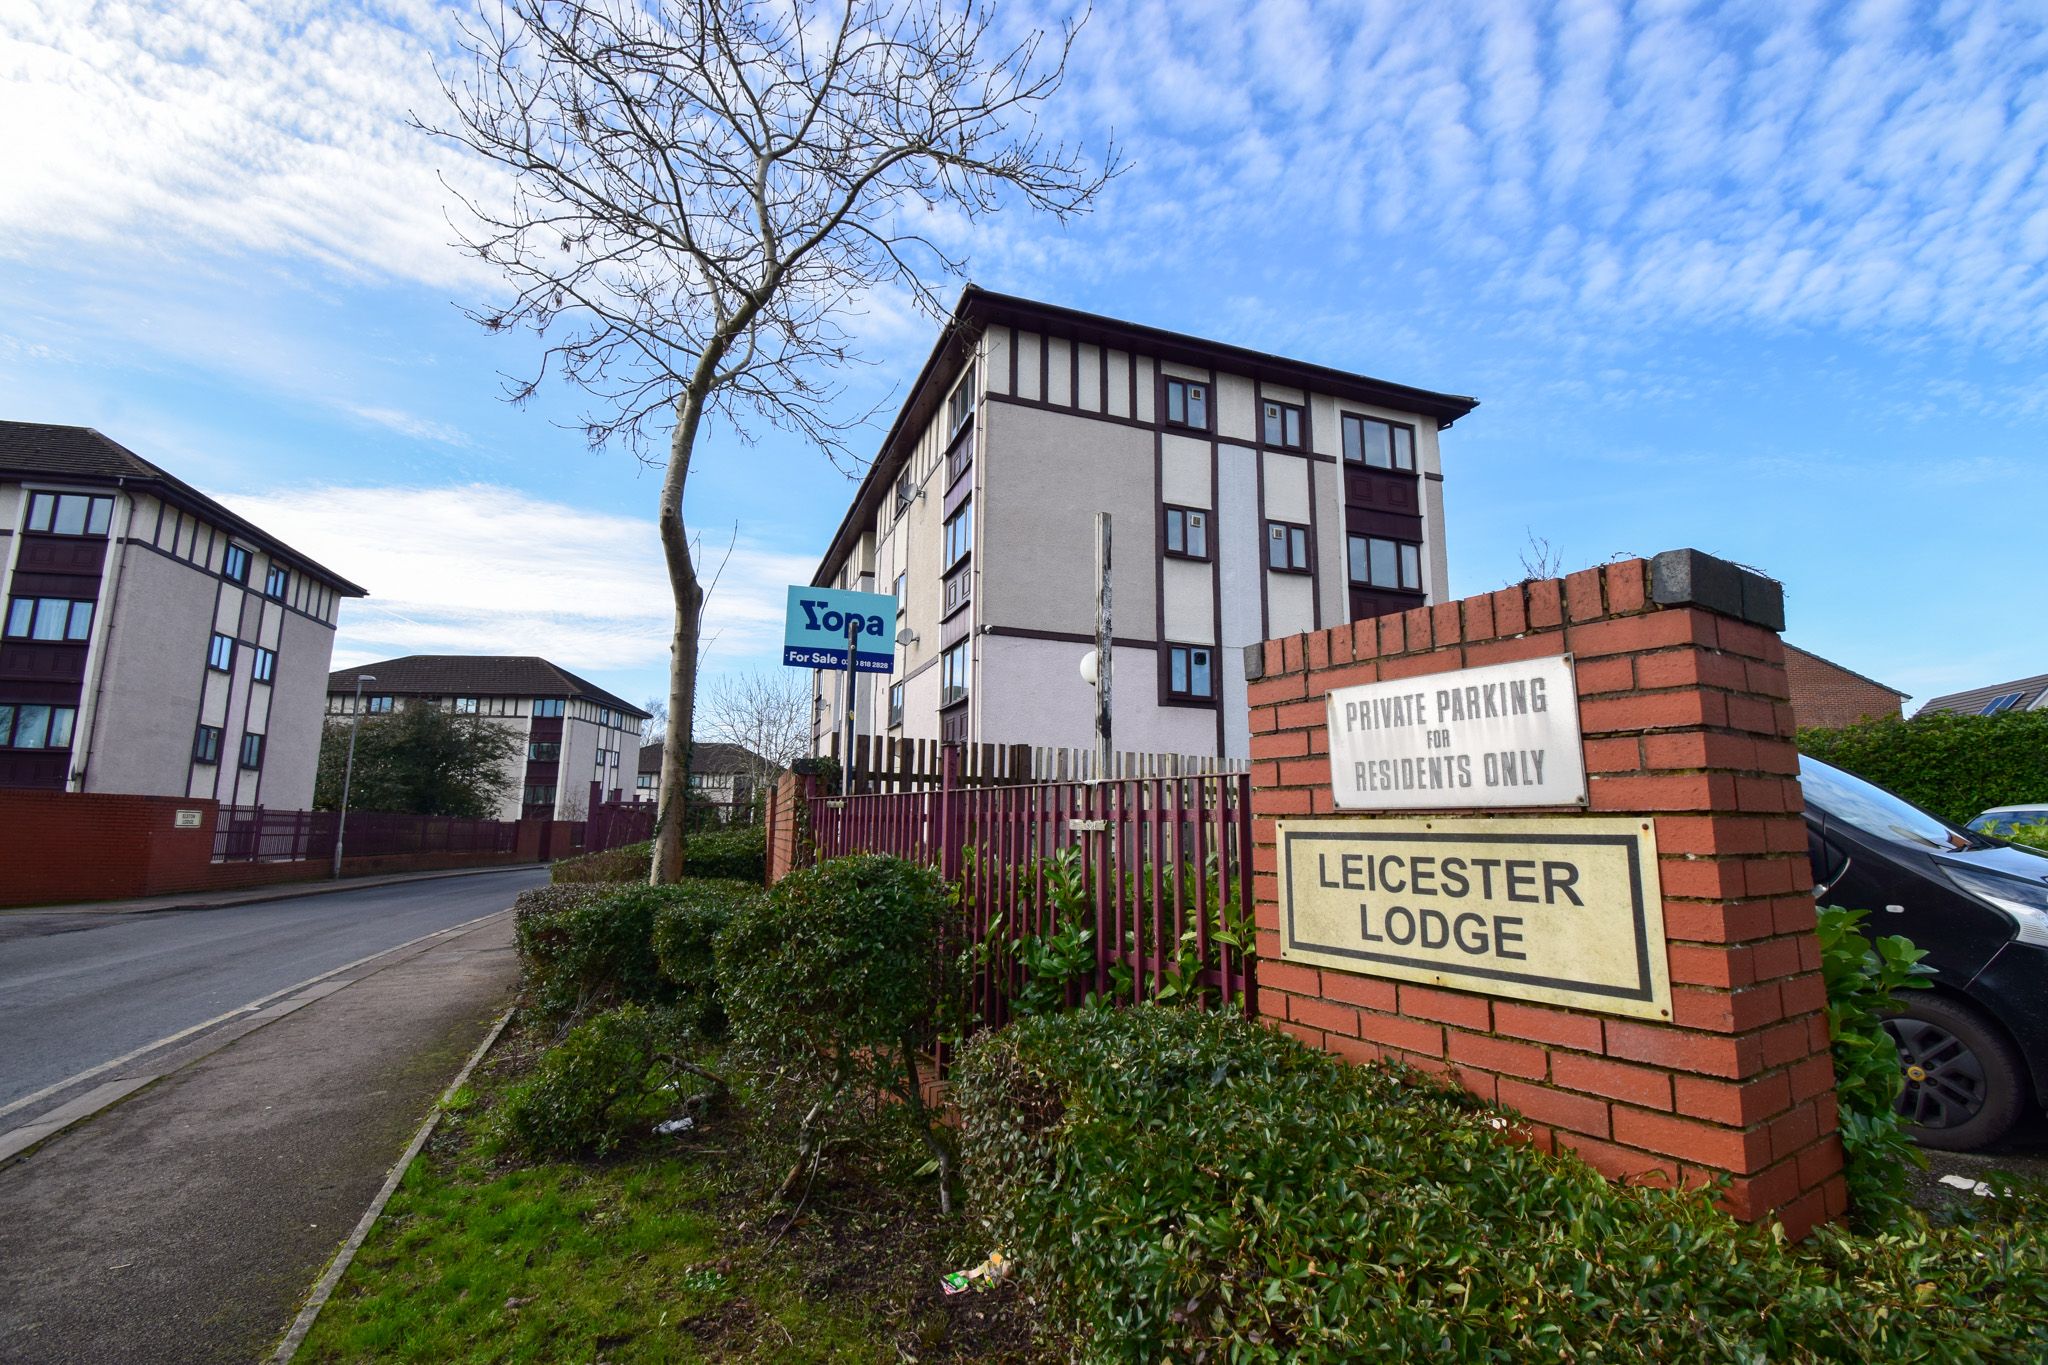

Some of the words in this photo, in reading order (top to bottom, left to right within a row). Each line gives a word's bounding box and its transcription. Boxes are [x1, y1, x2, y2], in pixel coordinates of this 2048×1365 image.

[800, 600, 884, 638] Yopa
[789, 651, 809, 663] For
[811, 652, 838, 665] Sale
[859, 660, 871, 668] 818
[872, 661, 889, 669] 2828
[1346, 693, 1426, 732] PRIVATE
[1436, 677, 1548, 723] PARKING
[1427, 729, 1451, 749] FOR
[1355, 754, 1472, 791] RESIDENTS
[1484, 750, 1545, 787] ONLY
[1318, 852, 1585, 906] LEICESTER
[1360, 903, 1527, 961] LODGE
